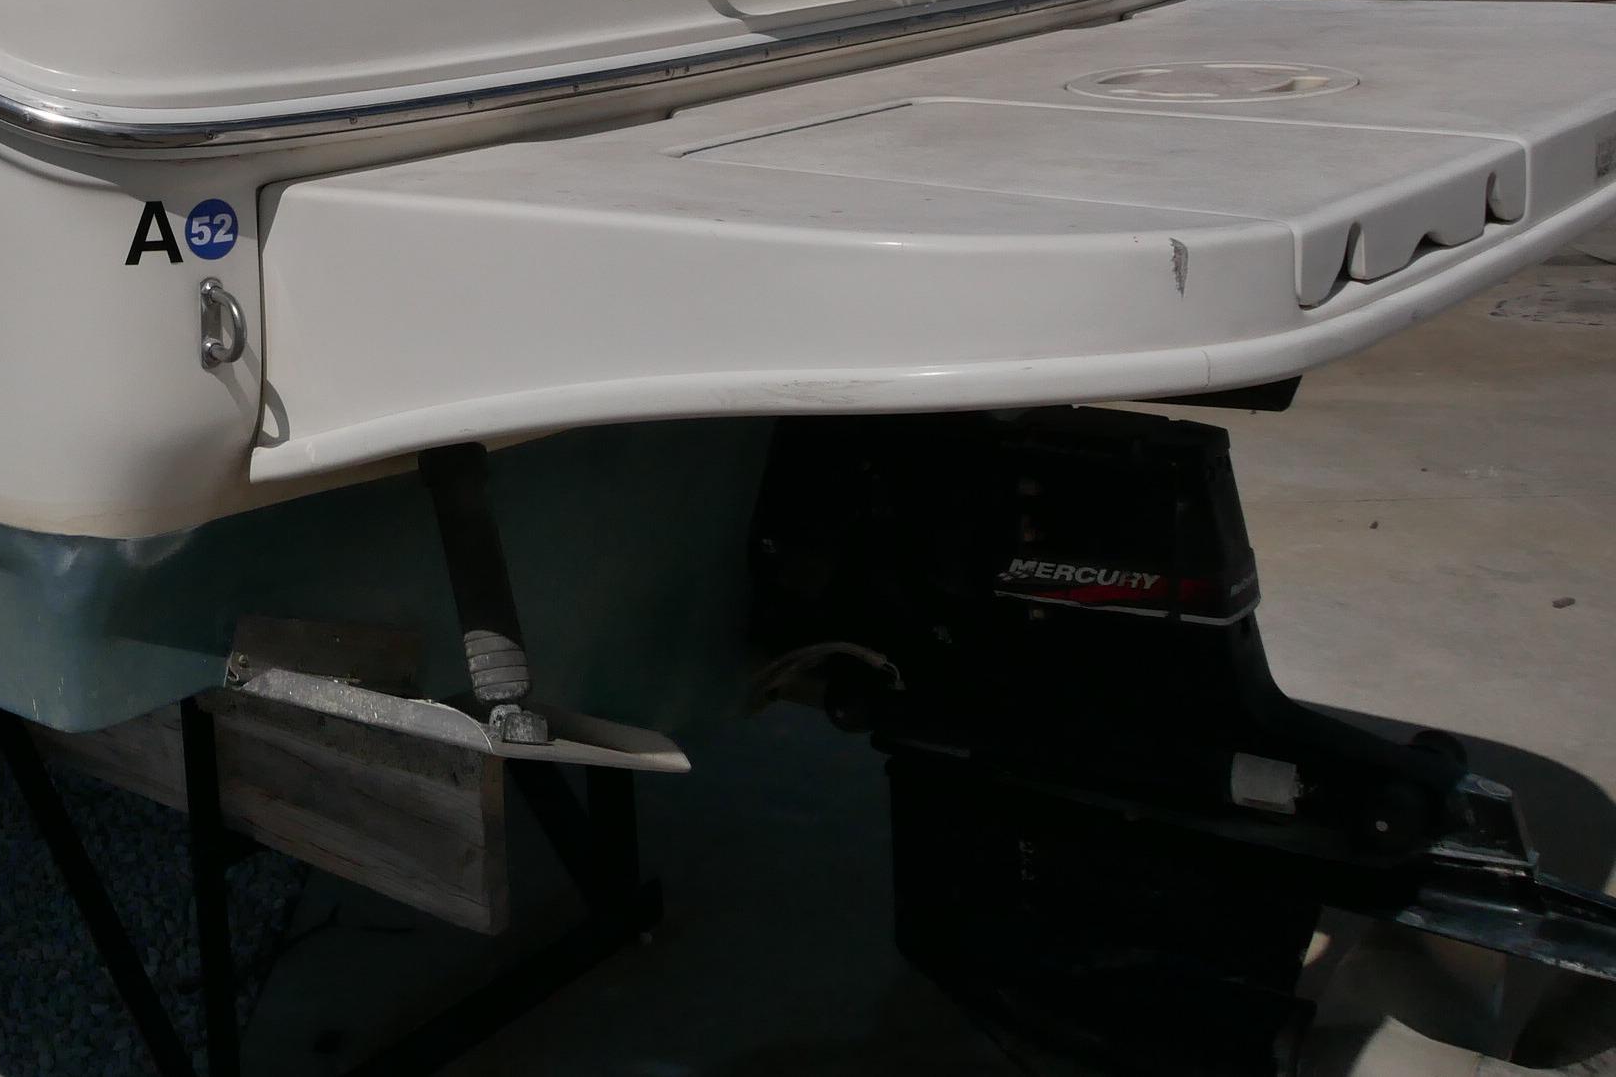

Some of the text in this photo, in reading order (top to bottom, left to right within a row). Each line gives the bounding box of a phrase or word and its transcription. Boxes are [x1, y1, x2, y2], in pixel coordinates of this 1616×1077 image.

[124, 200, 234, 266] A 52
[1007, 557, 1161, 591] MERCURY
